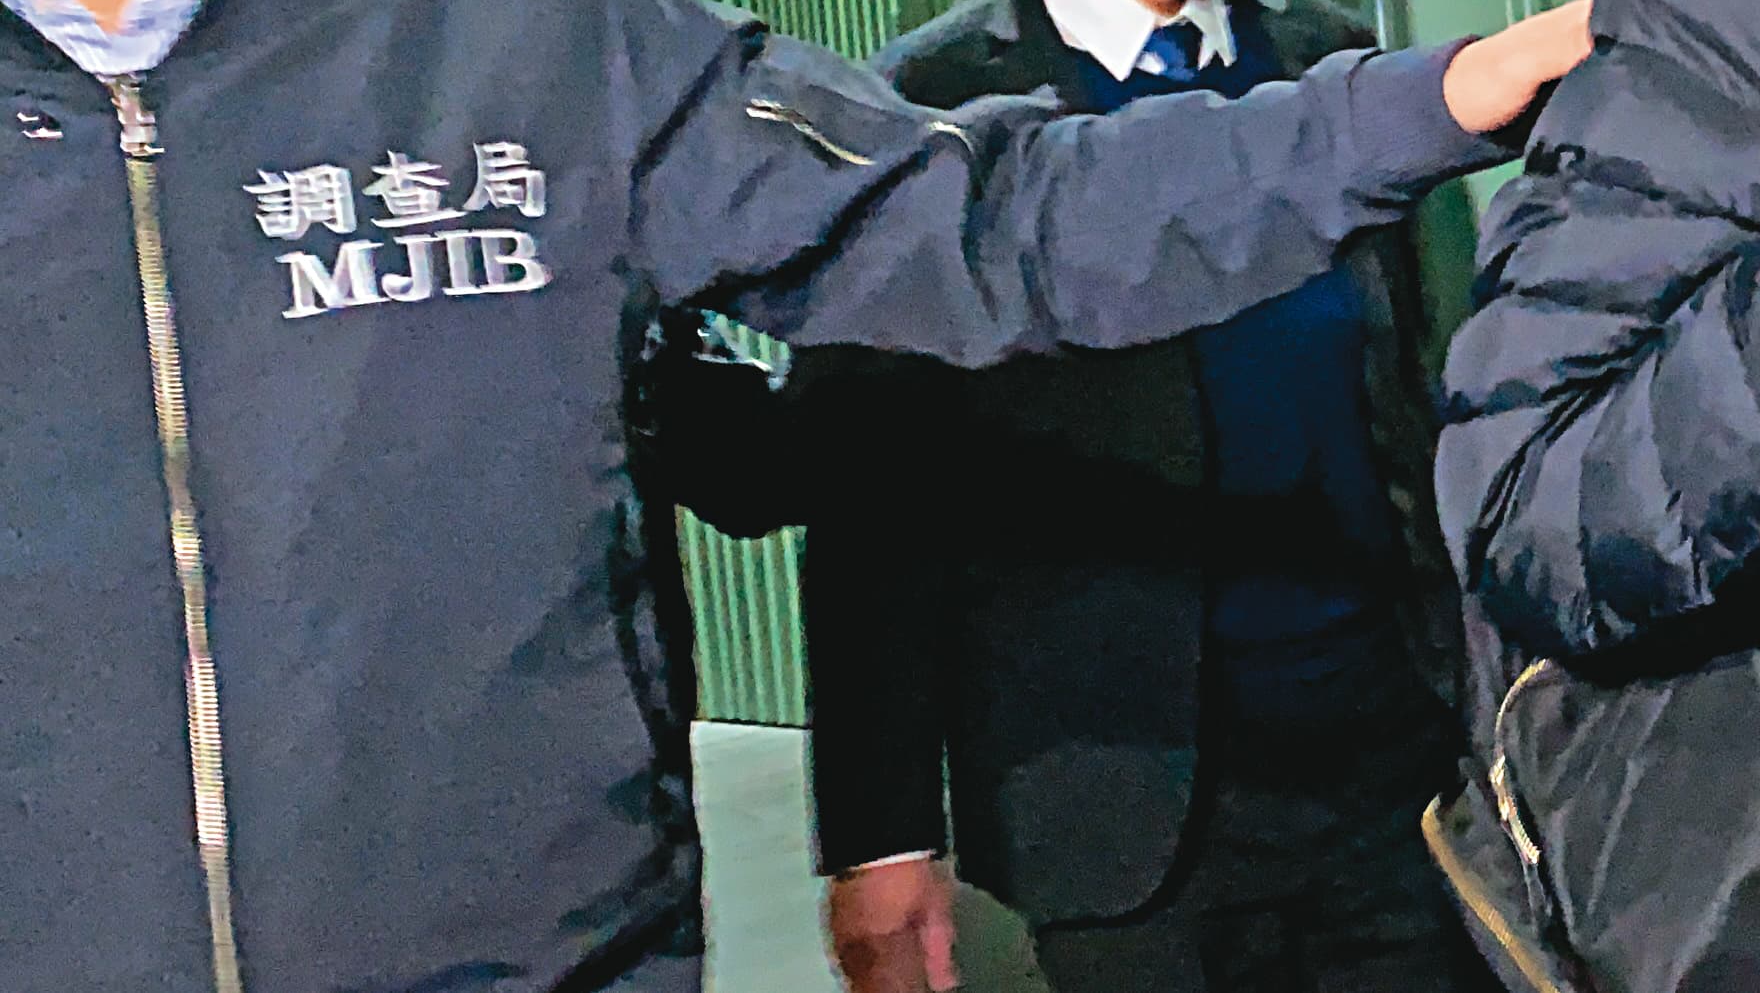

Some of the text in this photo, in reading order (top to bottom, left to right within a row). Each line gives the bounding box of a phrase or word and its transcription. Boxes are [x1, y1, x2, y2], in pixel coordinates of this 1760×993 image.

[243, 141, 546, 240] 調查局
[275, 228, 553, 319] MJIB
